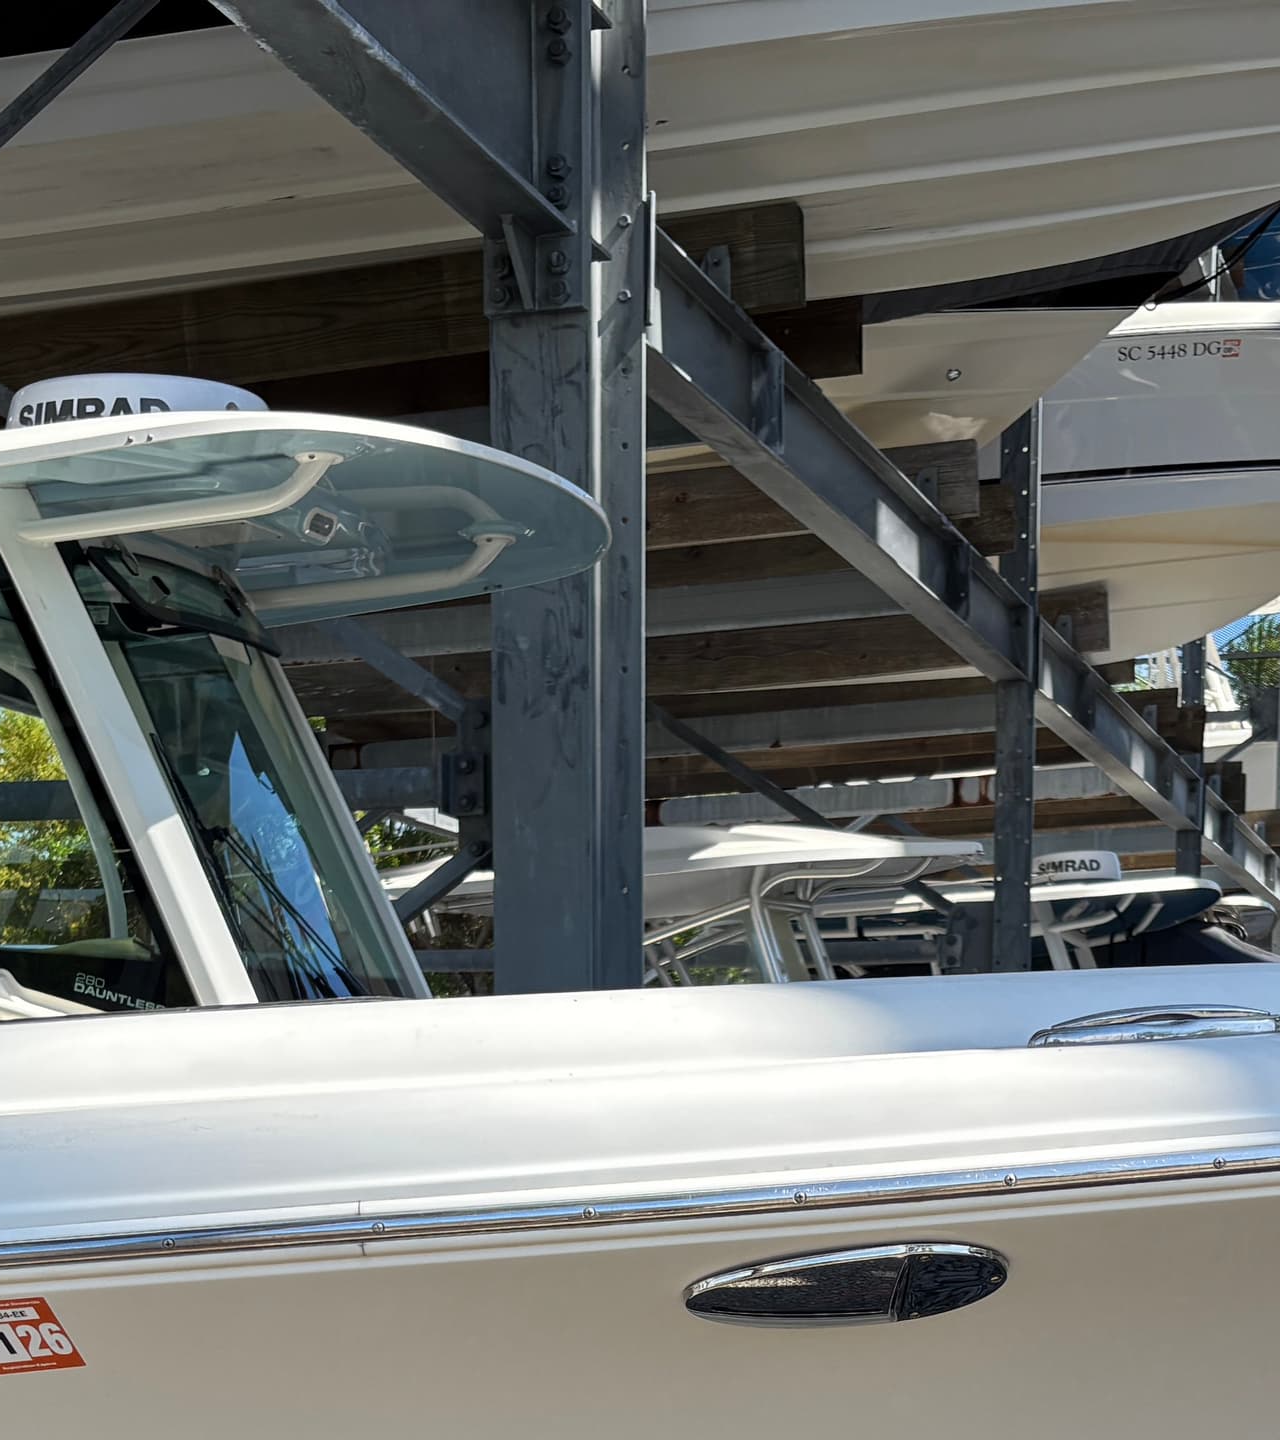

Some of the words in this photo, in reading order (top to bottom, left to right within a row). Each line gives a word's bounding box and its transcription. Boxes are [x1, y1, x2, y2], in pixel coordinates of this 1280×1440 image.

[1117, 345, 1142, 361] SC
[1147, 343, 1188, 360] 5448
[1193, 340, 1222, 356] DG
[19, 397, 172, 427] SIMRAD
[1038, 859, 1101, 873] SIMRAD
[75, 972, 105, 988] 280
[15, 1322, 73, 1358] 26
